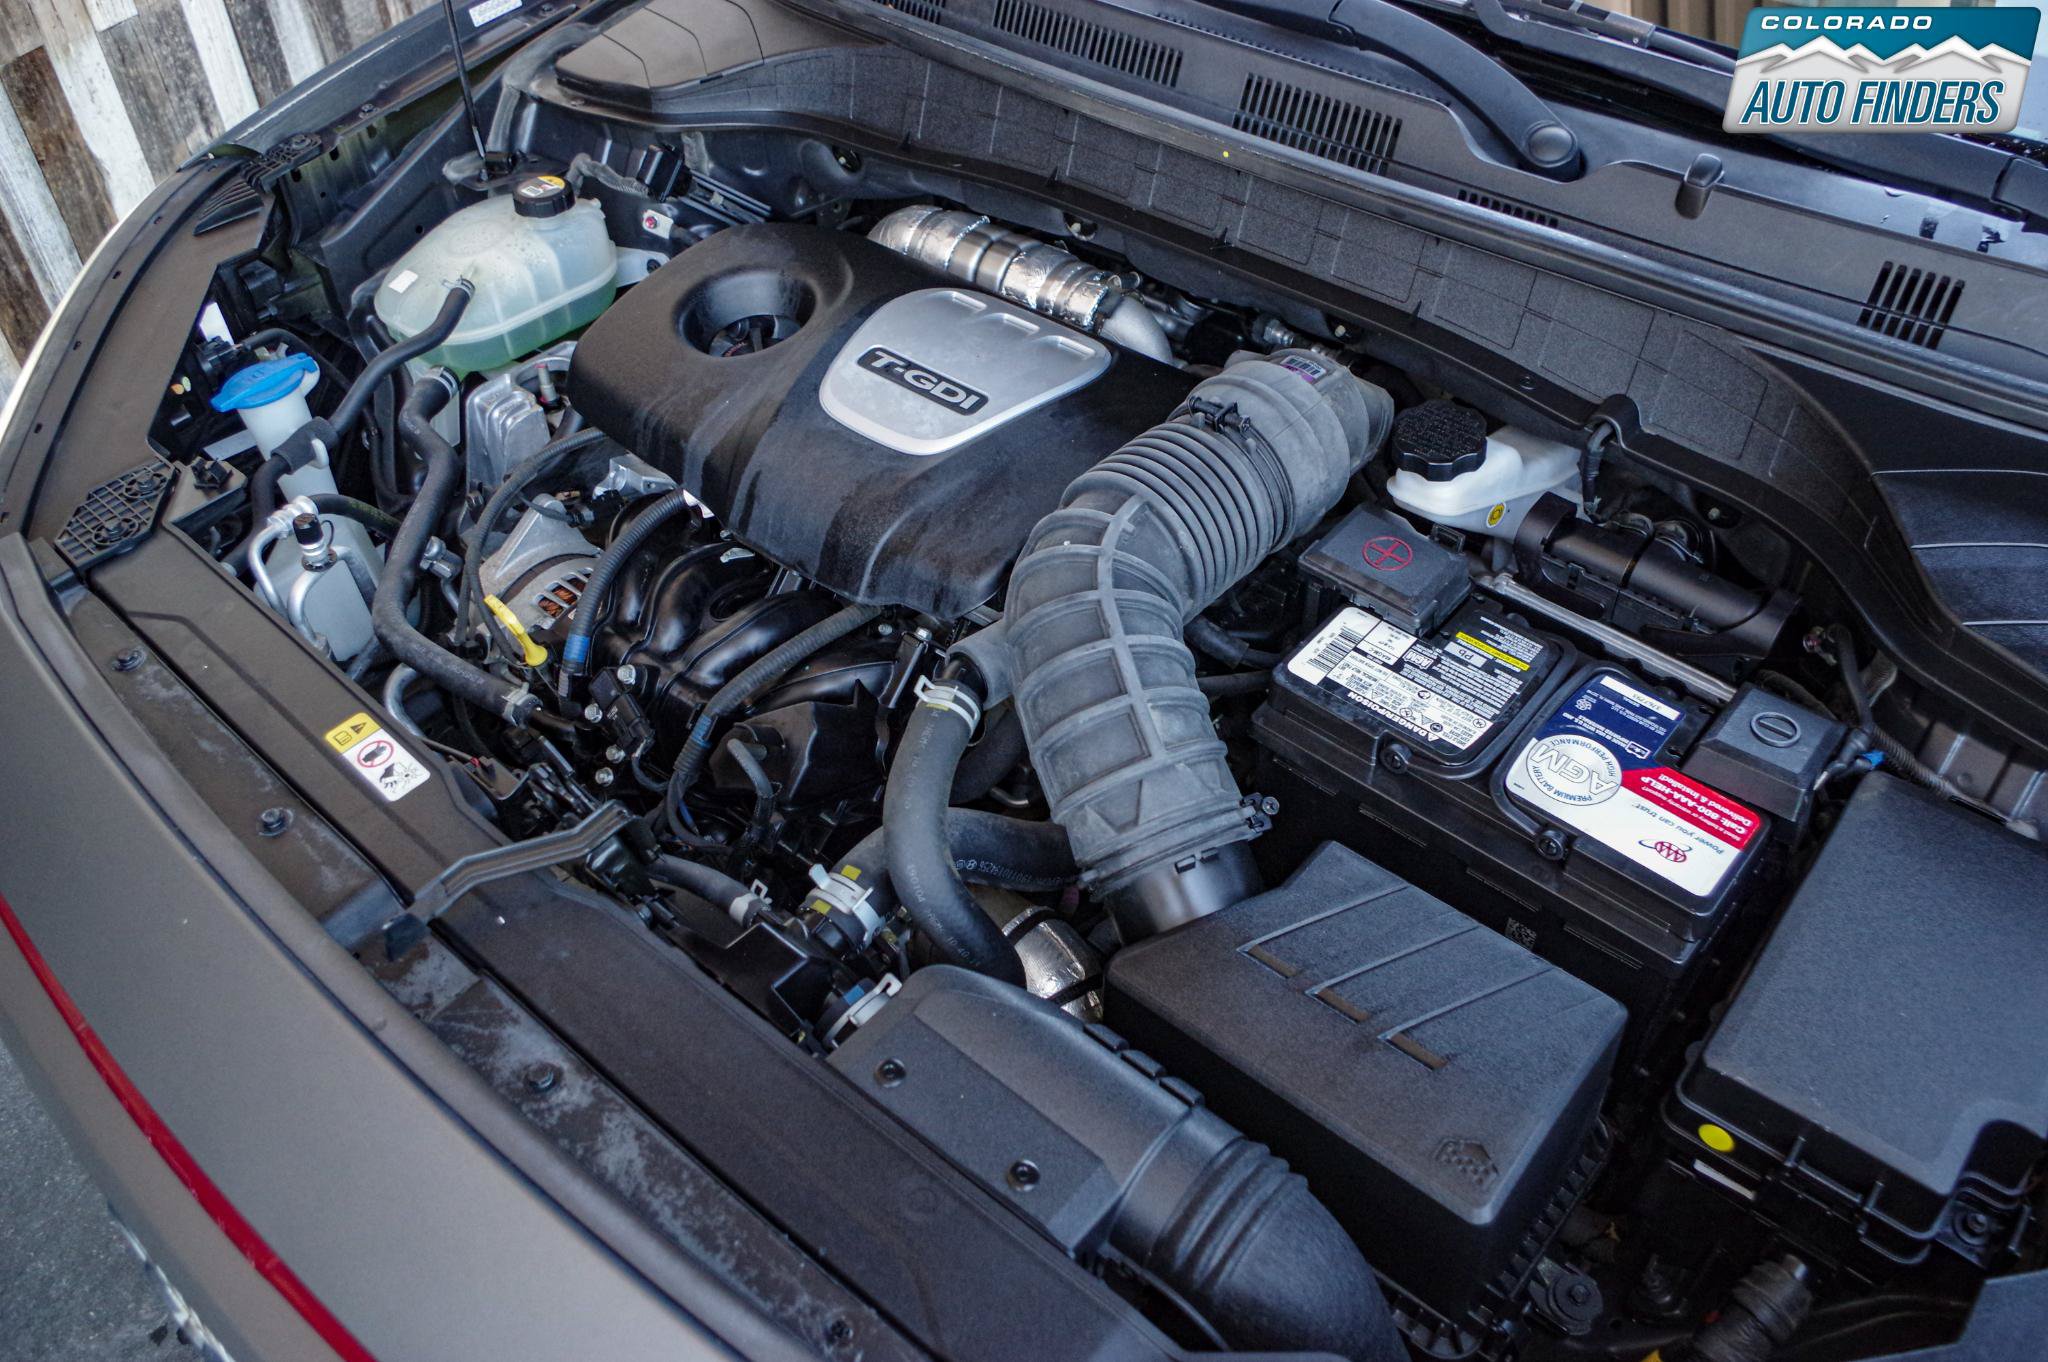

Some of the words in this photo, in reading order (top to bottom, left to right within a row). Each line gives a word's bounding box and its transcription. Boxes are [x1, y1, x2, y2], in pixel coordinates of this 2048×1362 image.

[870, 349, 980, 410] T-GDI
[1406, 652, 1431, 667] AGM
[1457, 649, 1474, 660] Pb
[1622, 696, 1640, 707] SERIAL
[1346, 691, 1429, 737] DANGER/POISON
[1562, 711, 1575, 720] AND
[1577, 714, 1606, 731] MATERIALS
[1582, 722, 1596, 732] WITH
[1595, 729, 1606, 737] USA
[1604, 729, 1630, 744] IMPORTED
[1611, 738, 1627, 749] MADE
[1550, 738, 1608, 762] PERFORMANCE
[1530, 743, 1618, 795] AGM
[1606, 760, 1616, 777] HIGH
[1532, 766, 1555, 791] BATTERY
[1658, 773, 1700, 799] Installed!
[1554, 789, 1593, 802] PREMIUM
[1640, 774, 1721, 821] 800-AAA-HELP
[1698, 795, 1709, 803] &
[1658, 816, 1676, 828] can
[1707, 800, 1752, 827] Delivered
[1675, 825, 1695, 838] you
[1719, 817, 1747, 835] Call:
[1656, 841, 1685, 862] AAA
[1694, 836, 1725, 855] Power
